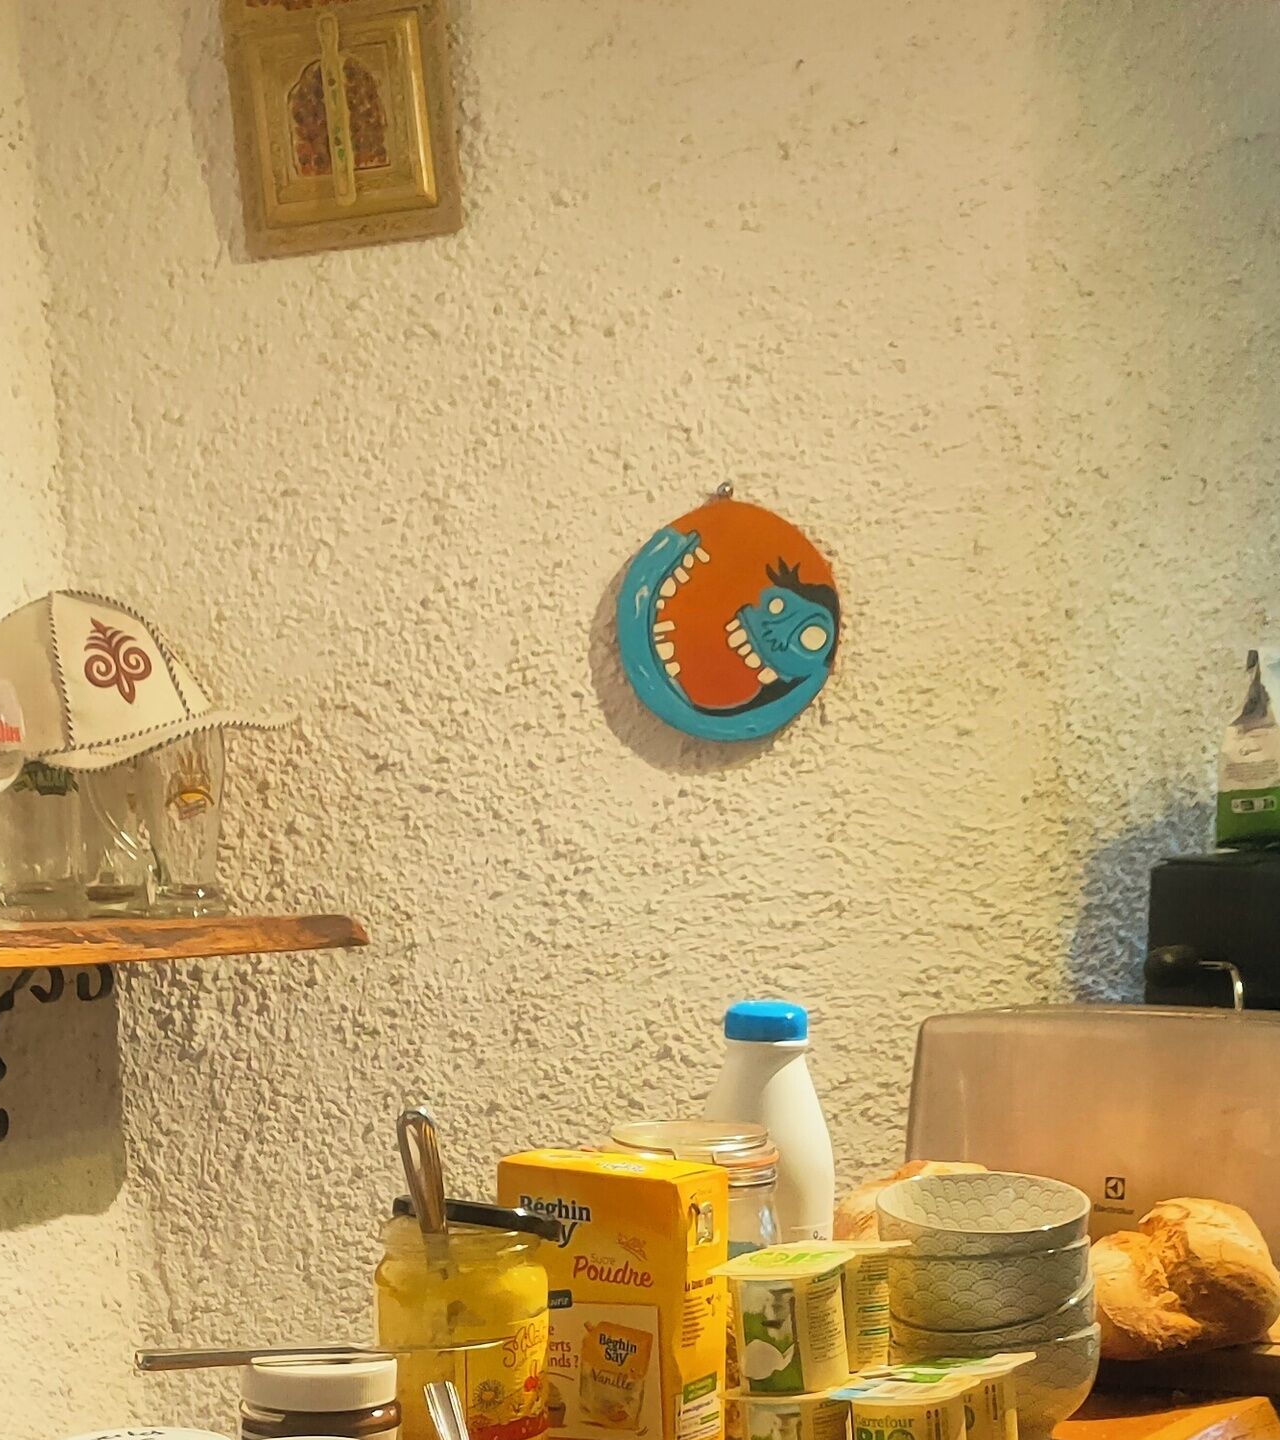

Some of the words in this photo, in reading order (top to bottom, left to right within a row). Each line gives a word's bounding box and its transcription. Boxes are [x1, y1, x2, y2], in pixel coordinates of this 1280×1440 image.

[519, 1195, 592, 1222] Béghin
[573, 1255, 654, 1288] Poudre
[599, 1333, 637, 1354] Béghin
[604, 1349, 629, 1366] Say
[591, 1368, 635, 1391] Vanille
[855, 1414, 915, 1429] Carrefour
